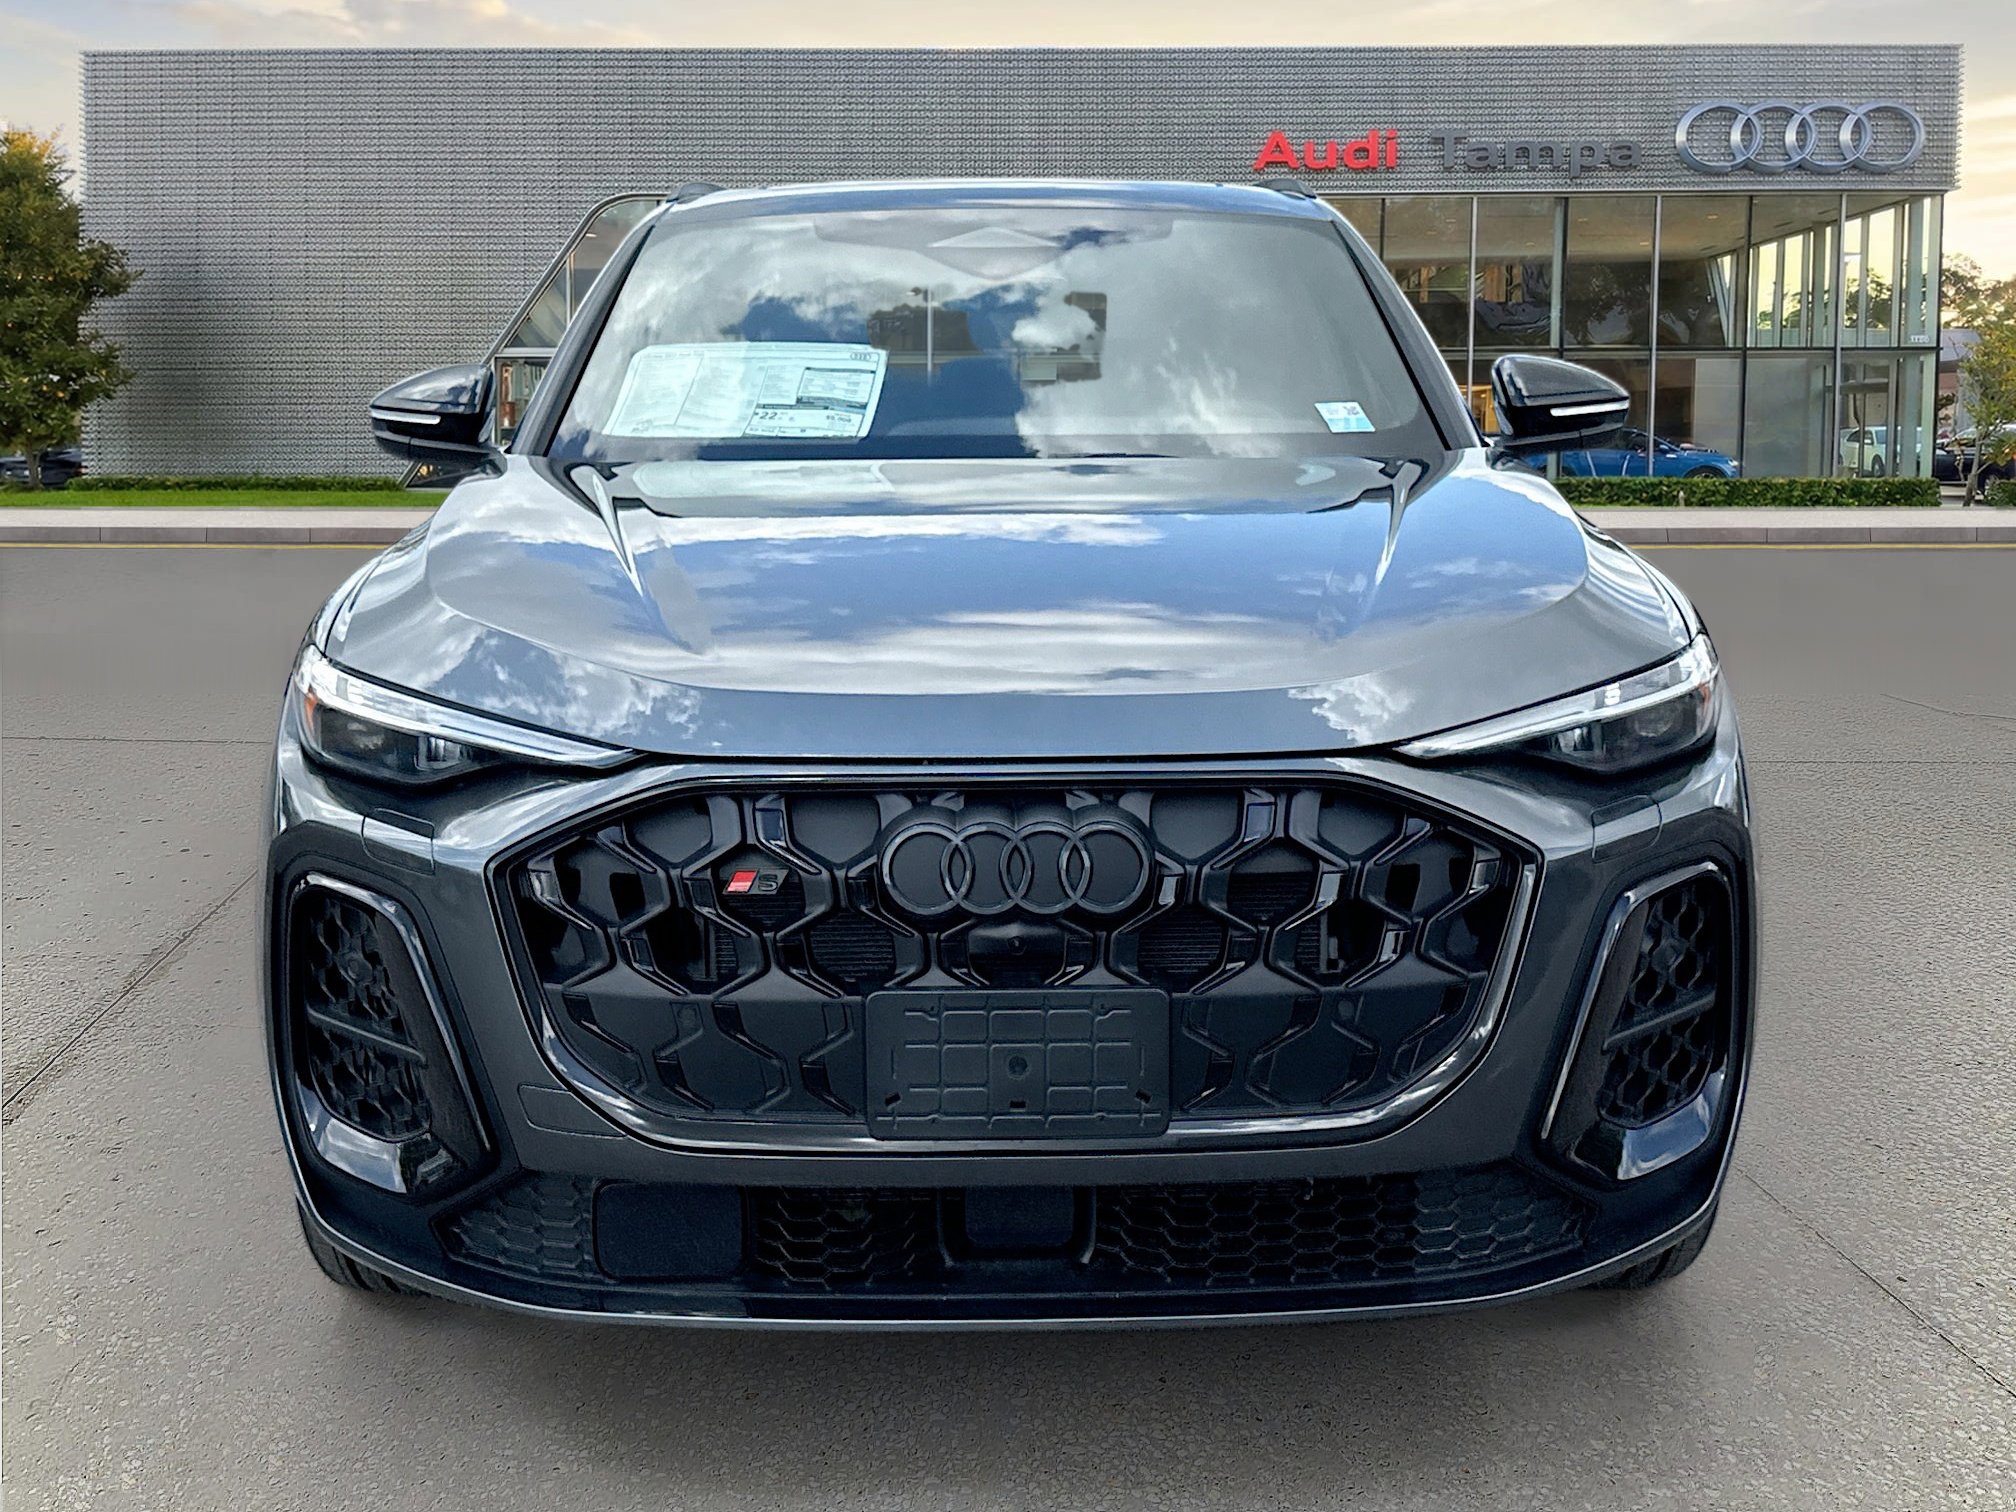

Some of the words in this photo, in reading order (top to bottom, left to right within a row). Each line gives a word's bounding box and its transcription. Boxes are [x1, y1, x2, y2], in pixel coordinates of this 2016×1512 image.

[1253, 129, 1399, 171] Audi
[1430, 128, 1643, 179] Tampa
[759, 411, 778, 420] 22
